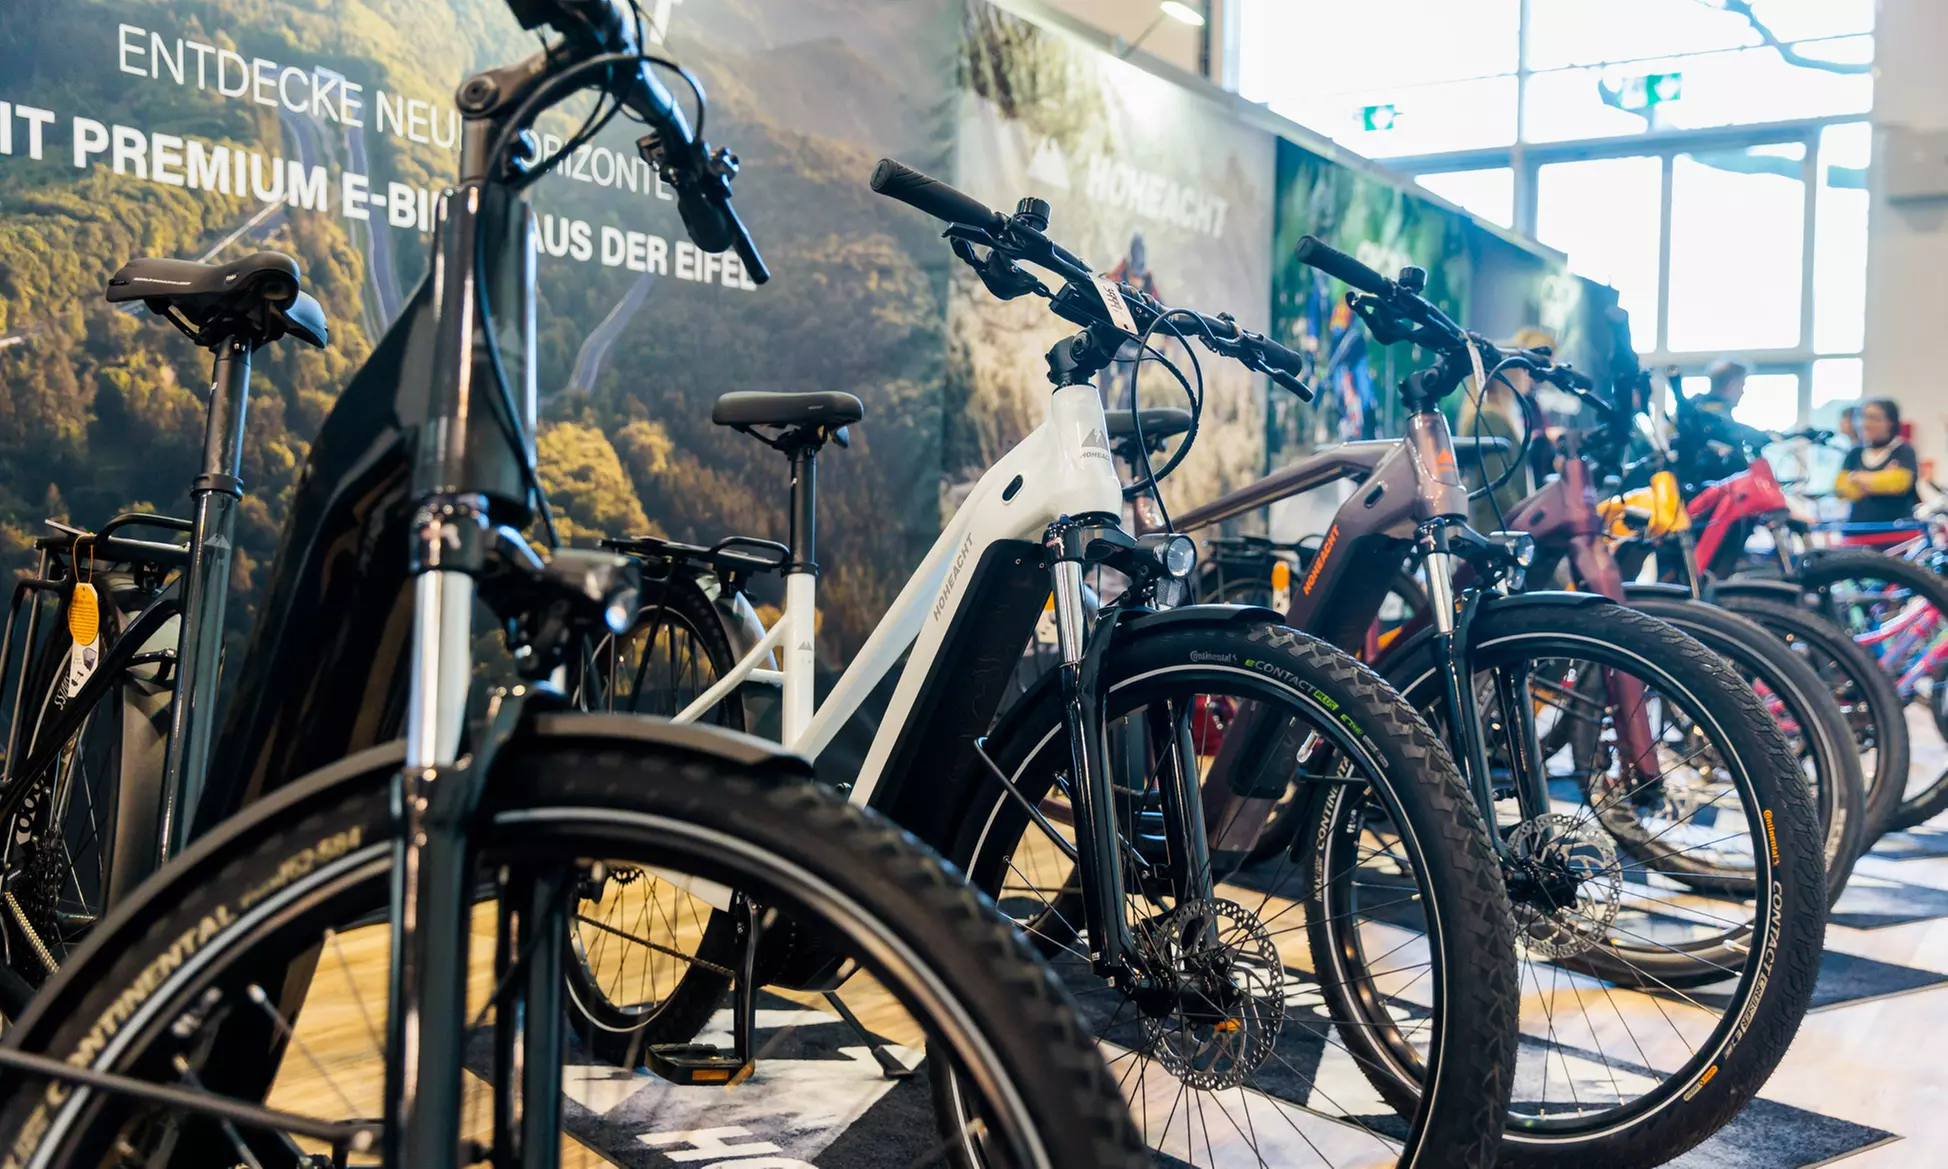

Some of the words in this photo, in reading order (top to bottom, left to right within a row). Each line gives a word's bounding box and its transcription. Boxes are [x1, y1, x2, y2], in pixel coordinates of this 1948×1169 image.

[118, 23, 364, 128] ENTDECKE
[376, 90, 462, 151] NEU
[520, 129, 674, 201] ORIZONTE
[0, 101, 55, 161] IT
[73, 116, 328, 213] PREMIUM
[342, 171, 440, 233] E-BI
[601, 225, 667, 276] DER
[1086, 152, 1229, 240] HOHEACHT
[933, 532, 974, 622] HOHEACHT
[1303, 523, 1340, 596] HOHEACHT
[1763, 809, 1780, 861] Continental
[1763, 880, 1783, 977] CONTACT
[1741, 974, 1767, 1031] CRUISER
